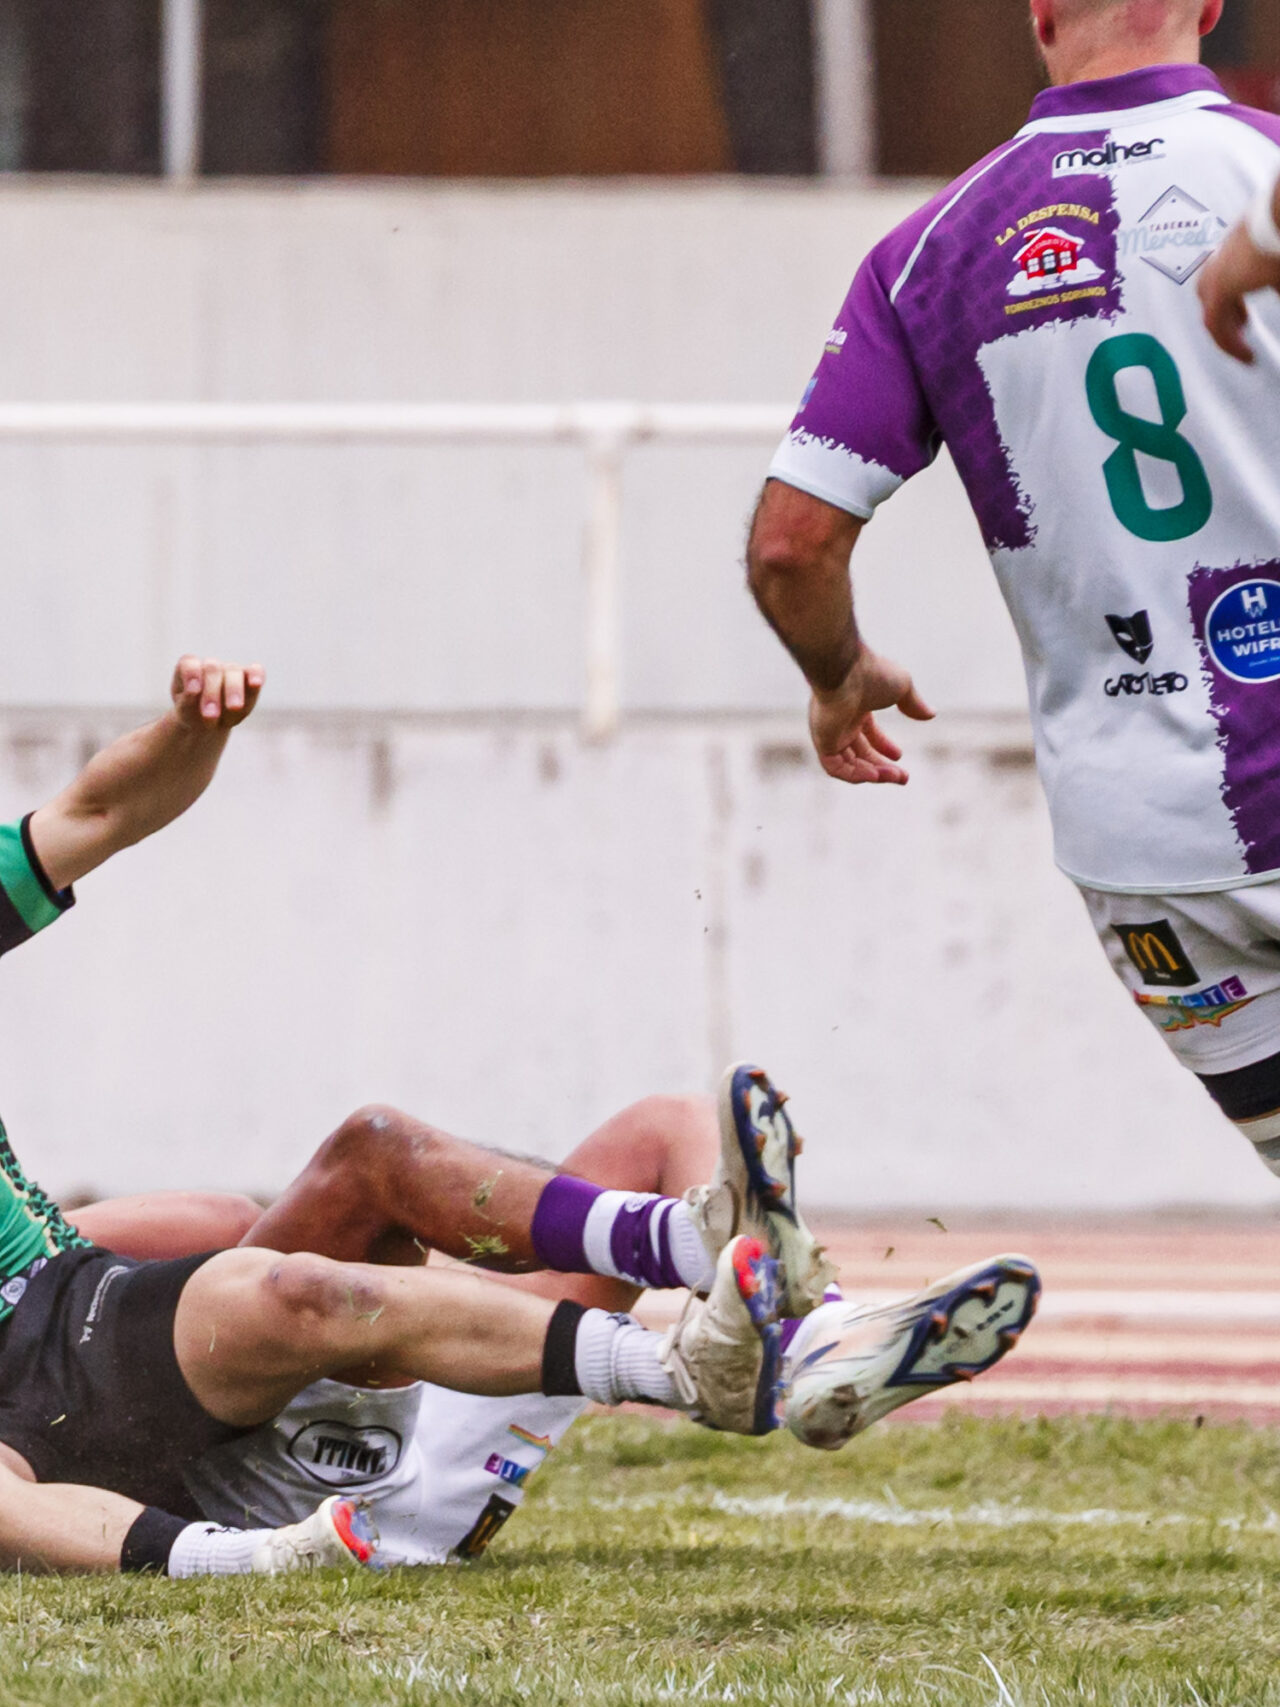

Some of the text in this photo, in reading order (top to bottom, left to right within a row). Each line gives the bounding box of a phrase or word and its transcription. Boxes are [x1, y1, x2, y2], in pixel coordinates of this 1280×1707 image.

[1055, 138, 1165, 169] molher
[994, 203, 1099, 246] LA DESPENSA
[1085, 332, 1213, 542] 8
[1216, 620, 1280, 642] HOTEL
